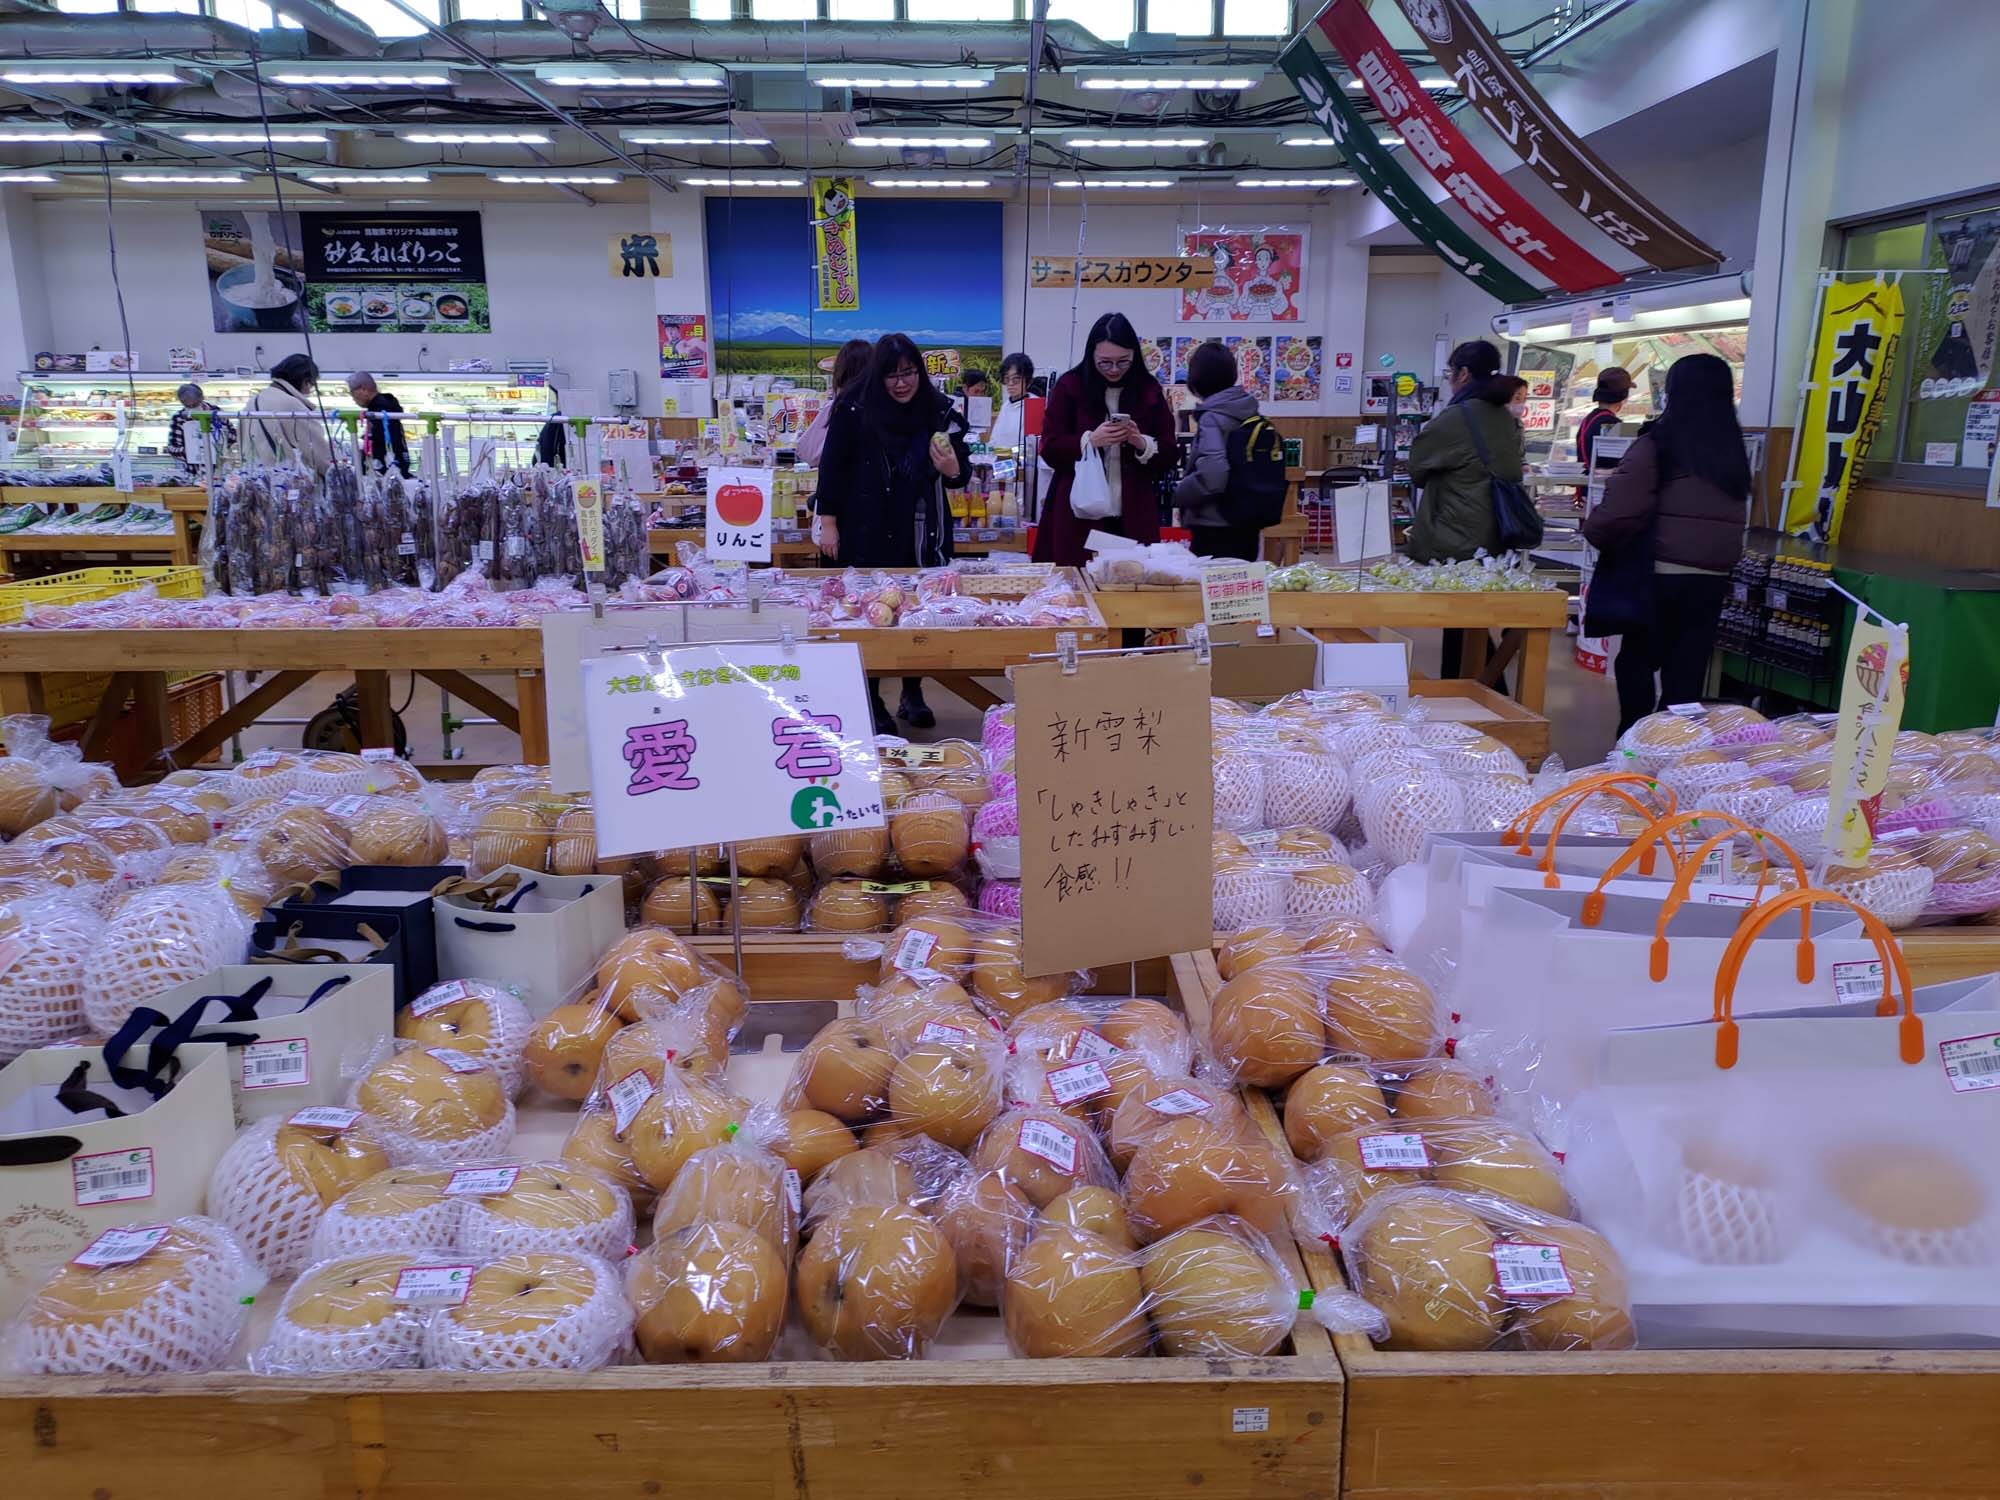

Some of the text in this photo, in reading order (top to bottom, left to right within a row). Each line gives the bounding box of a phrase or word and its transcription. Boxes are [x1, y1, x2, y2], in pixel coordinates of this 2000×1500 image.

[324, 240, 462, 264] 砂丘ねばりっこ
[1032, 260, 1214, 284] サービスカウンター
[716, 532, 764, 548] りんご
[1047, 707, 1162, 763] 新雪梨
[1037, 785, 1190, 823] 「しゃきしゃき」と
[1050, 818, 1196, 853] したみずみずしい
